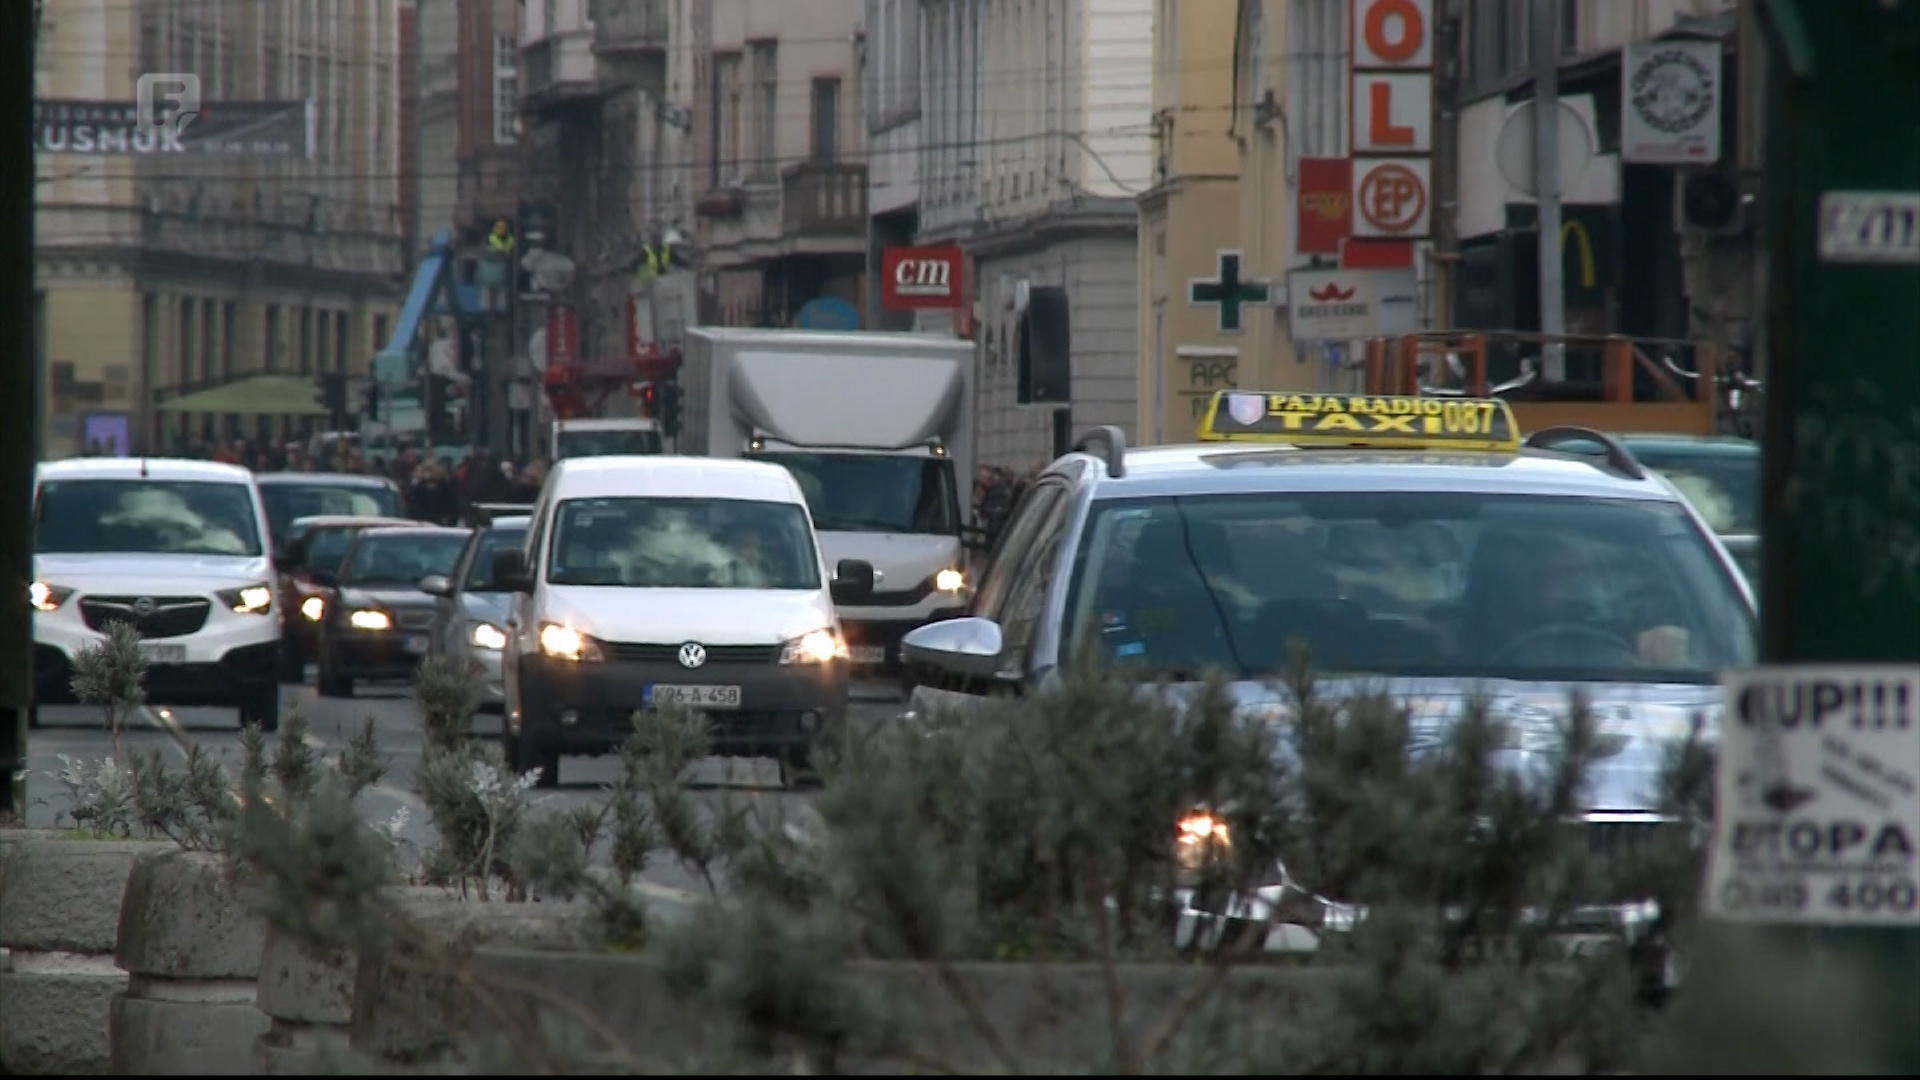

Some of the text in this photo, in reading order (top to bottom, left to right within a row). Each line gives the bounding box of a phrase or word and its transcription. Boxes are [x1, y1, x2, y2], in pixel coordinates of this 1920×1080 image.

[1269, 394, 1443, 416] PAJA RADIO
[1269, 411, 1442, 434] TAXI
[1444, 401, 1495, 434] 087
